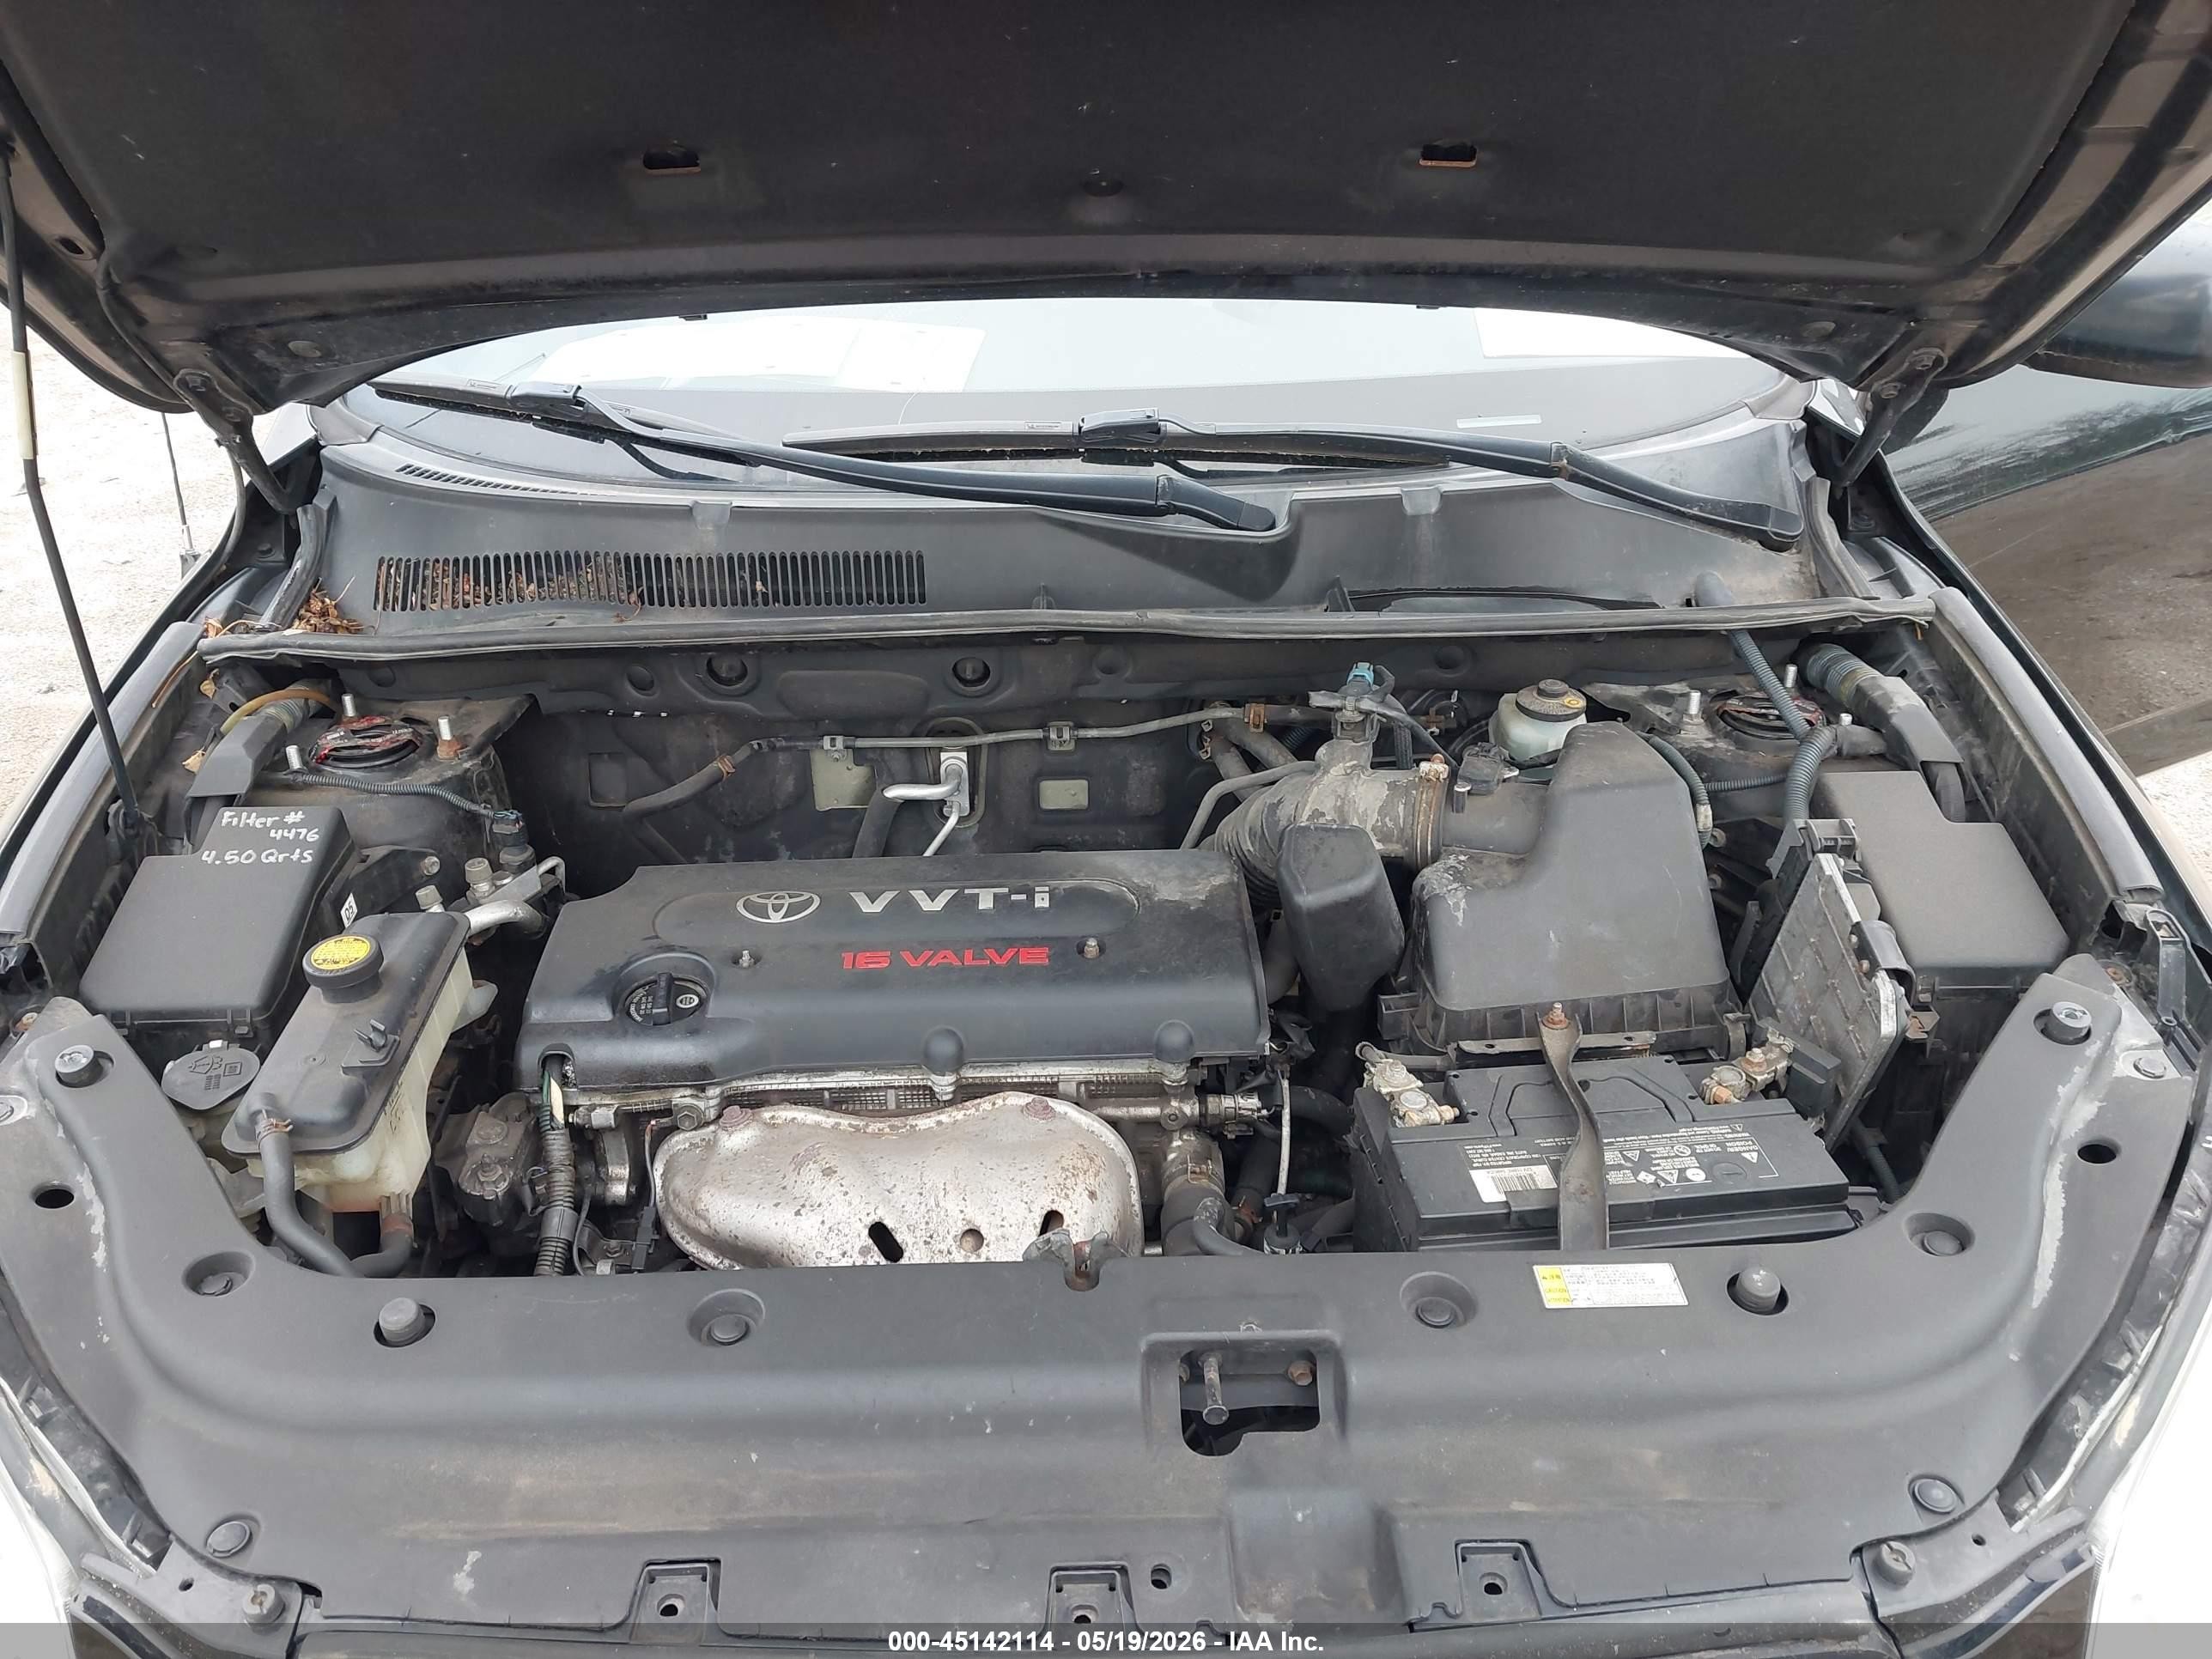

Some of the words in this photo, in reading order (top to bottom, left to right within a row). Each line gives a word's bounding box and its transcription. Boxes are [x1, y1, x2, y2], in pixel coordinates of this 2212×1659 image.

[221, 811, 280, 828] Filter
[283, 811, 305, 824] #
[269, 828, 319, 842] 4476
[201, 849, 257, 865] 4.50
[848, 886, 1049, 913] VVT-i
[841, 951, 891, 969] 16
[899, 947, 1049, 967] VALVE
